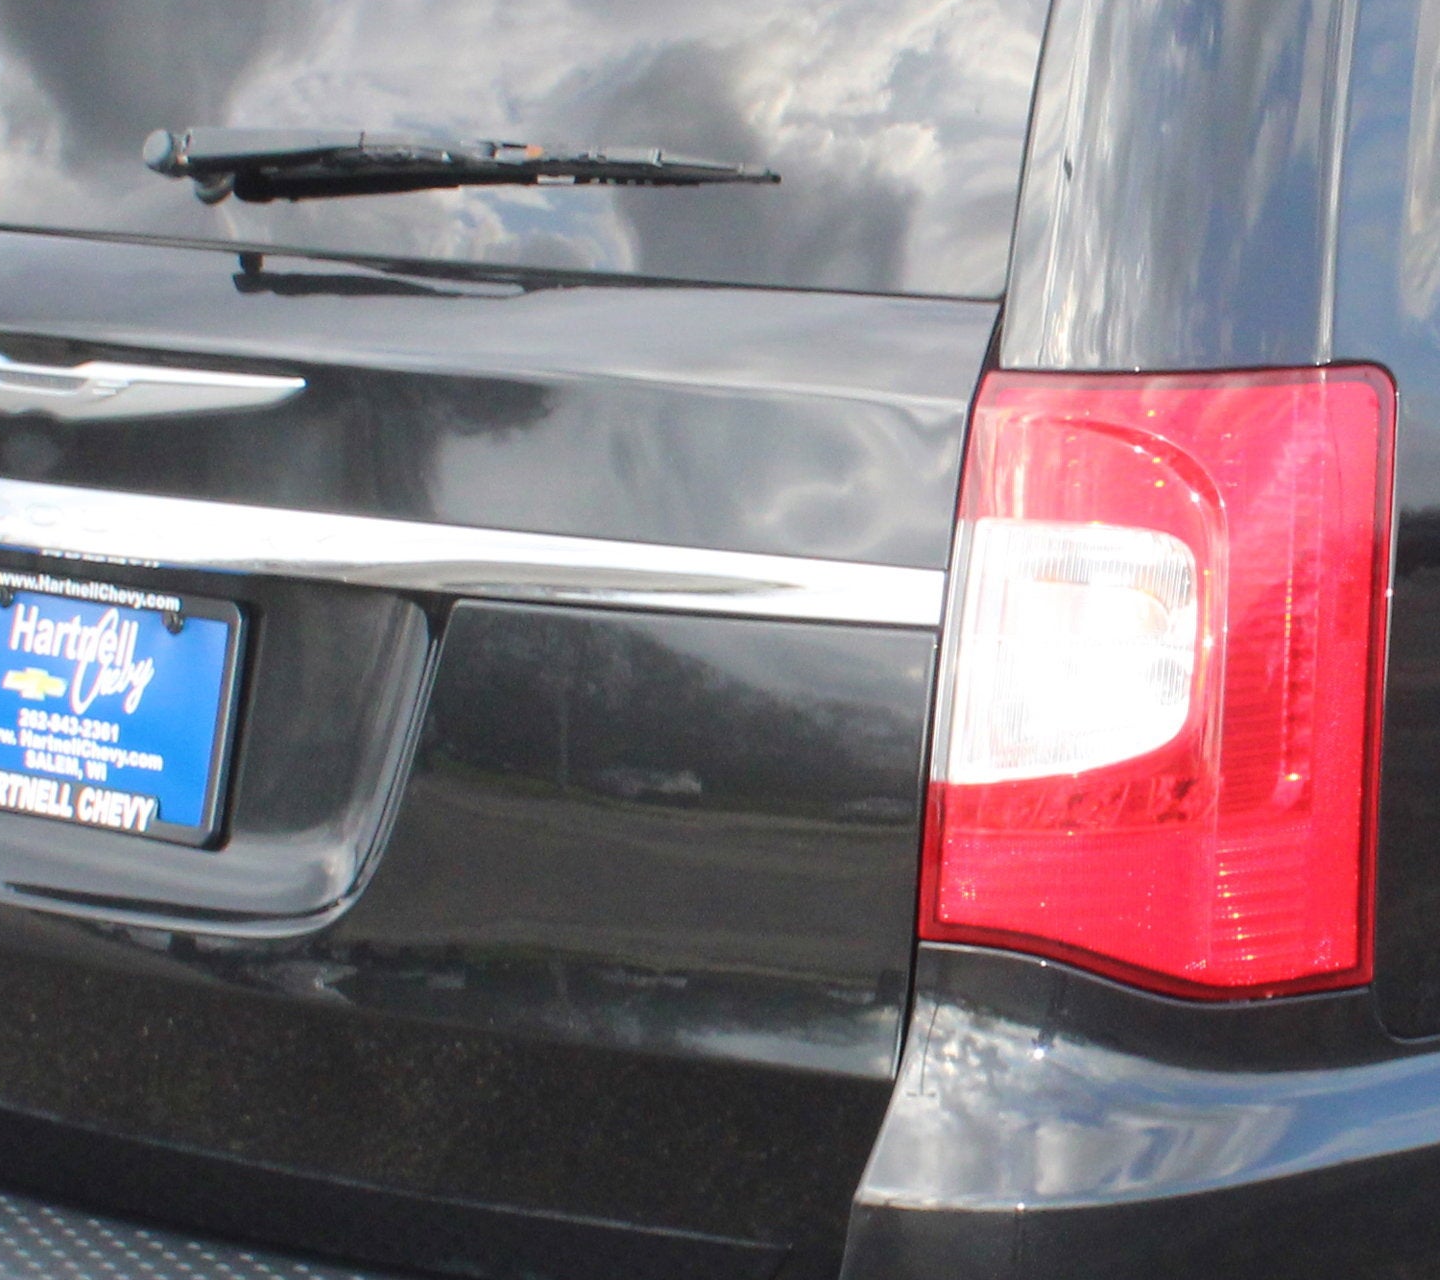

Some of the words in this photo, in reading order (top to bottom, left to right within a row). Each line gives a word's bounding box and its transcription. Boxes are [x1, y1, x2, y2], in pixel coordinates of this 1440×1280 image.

[10, 603, 139, 668] Hartnell
[85, 760, 107, 782] WI
[77, 787, 157, 832] CHEVY
